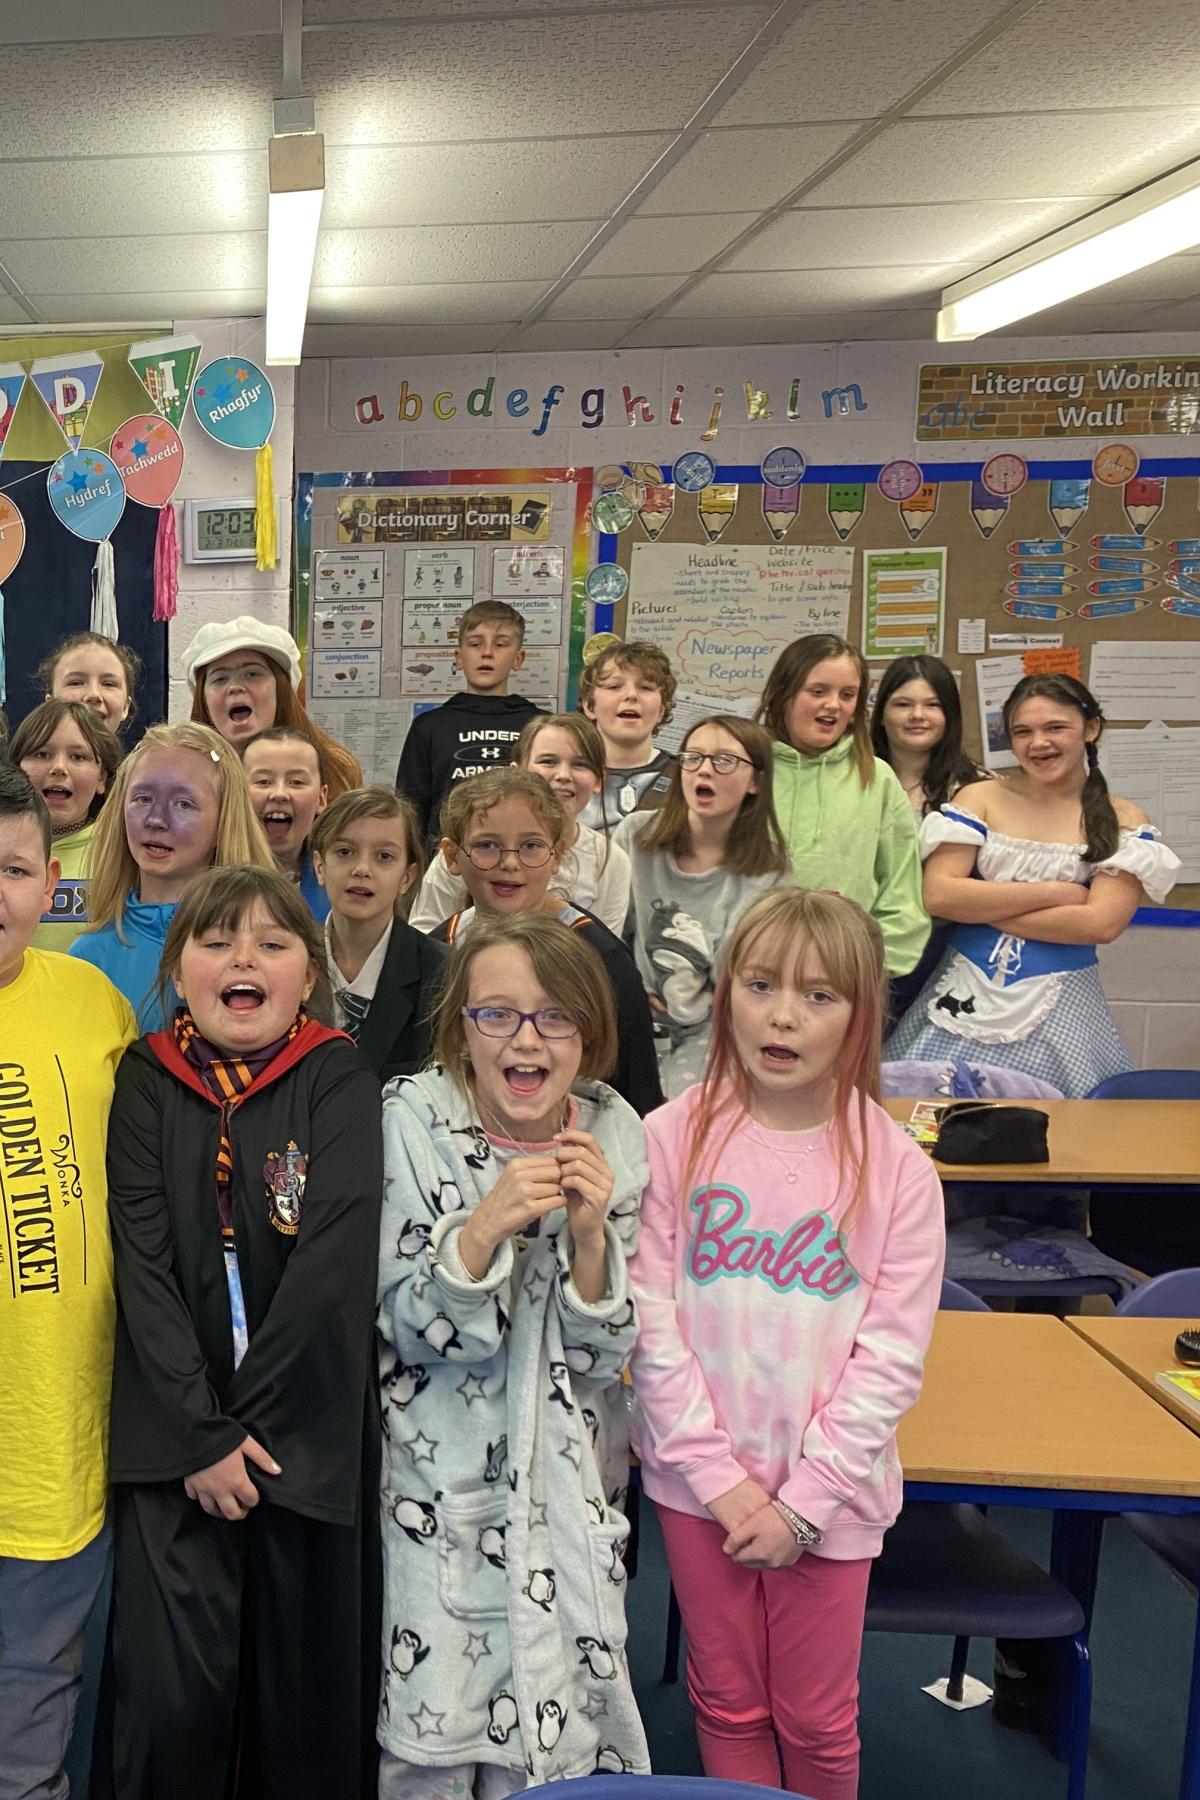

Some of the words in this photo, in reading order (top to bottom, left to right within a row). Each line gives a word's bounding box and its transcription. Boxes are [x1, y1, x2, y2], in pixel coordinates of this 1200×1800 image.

[970, 371, 1085, 398] Literacy
[1097, 364, 1200, 391] Workin
[208, 382, 264, 425] Rhagfyr
[355, 392, 385, 424] a
[398, 381, 422, 421] b
[432, 390, 458, 419] c
[467, 377, 495, 417] d
[506, 388, 530, 417] e
[532, 385, 564, 436] f
[580, 388, 604, 428] g
[623, 385, 655, 427] h
[670, 384, 684, 425] i
[700, 387, 725, 441] j
[743, 381, 773, 420] k
[821, 383, 868, 417] m
[1057, 402, 1125, 428] Wall
[119, 442, 180, 480] Tachwedd
[65, 480, 112, 510] Hydref
[206, 511, 255, 536] 12:03
[357, 510, 459, 531] Dictionary
[465, 509, 531, 526] Corner
[431, 551, 448, 560] verb
[688, 553, 737, 567] Headline
[632, 601, 677, 615] Pictures
[691, 637, 778, 660] Newspaper
[1030, 636, 1060, 645] Context
[325, 652, 369, 662] conjunction
[415, 651, 458, 660] prepositio
[709, 662, 764, 683] Reports
[10, 1185, 60, 1294] TICKET
[688, 1185, 857, 1300] Barbie
